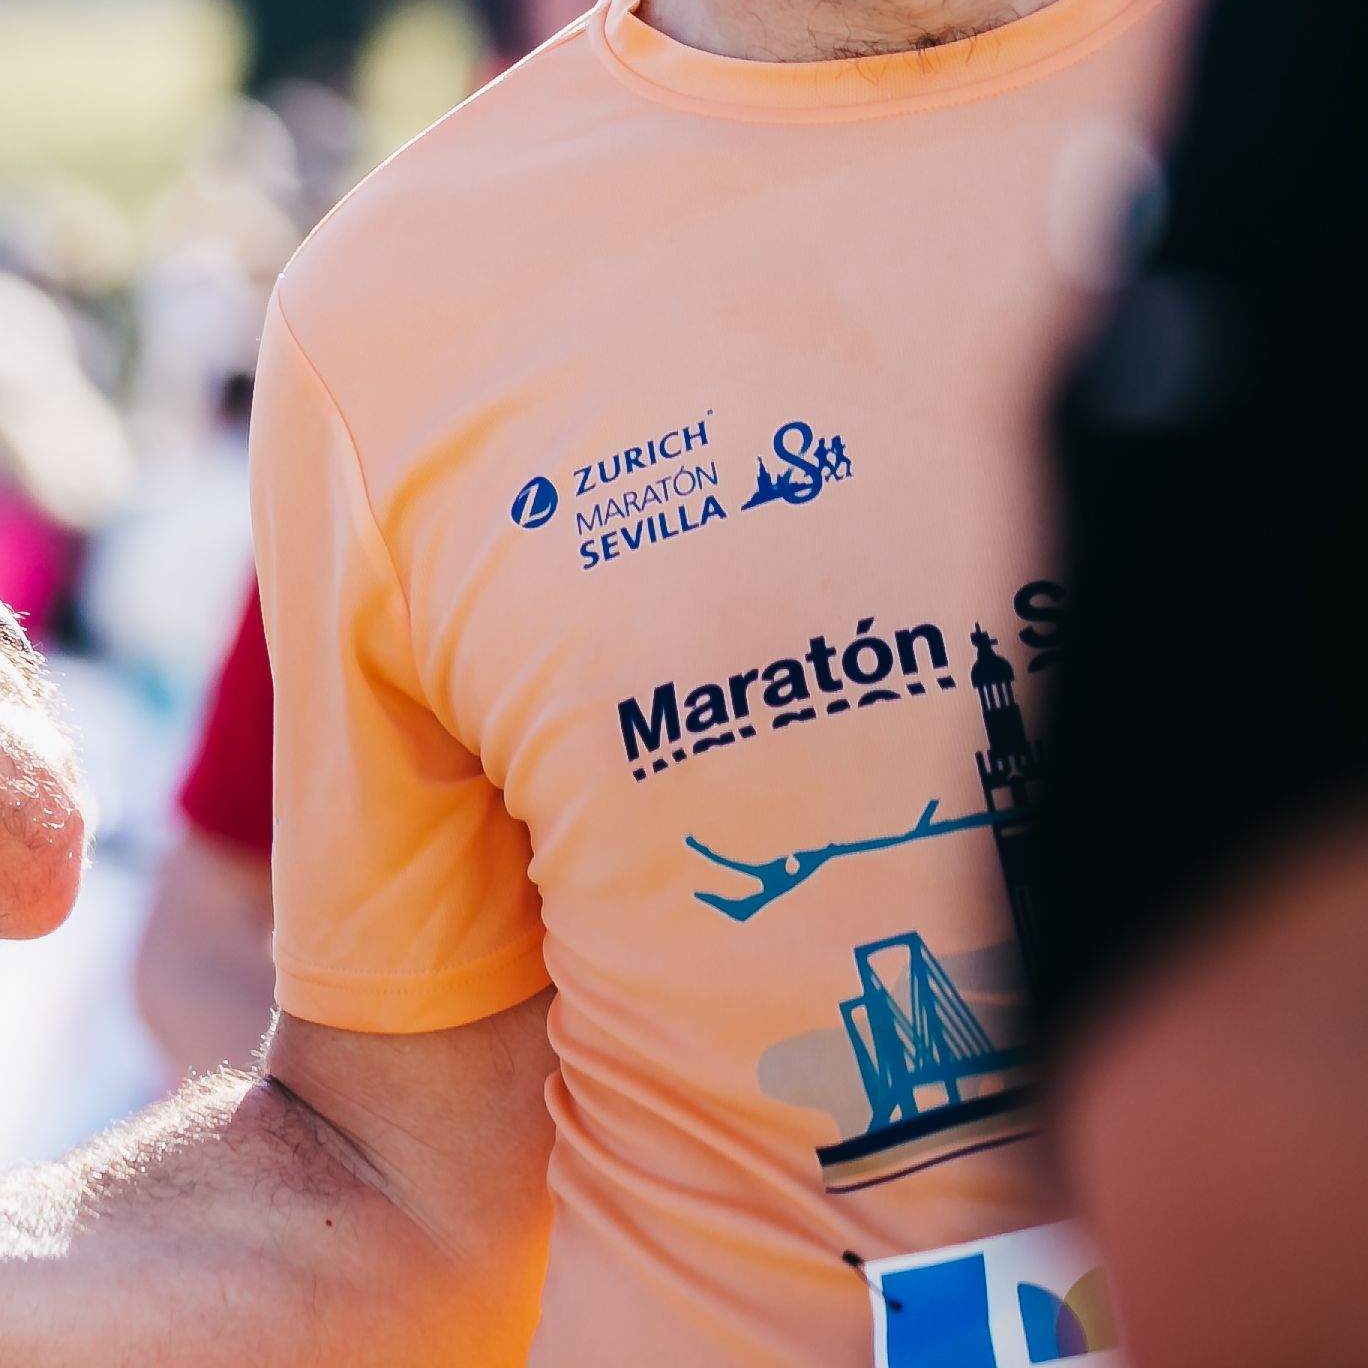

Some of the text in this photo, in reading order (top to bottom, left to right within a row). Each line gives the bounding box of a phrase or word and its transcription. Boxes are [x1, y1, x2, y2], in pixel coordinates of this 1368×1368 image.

[573, 421, 708, 496] ZURICH
[576, 461, 718, 535] MARATÓN
[580, 495, 727, 570] SEVILLA
[618, 617, 948, 762] Maratón
